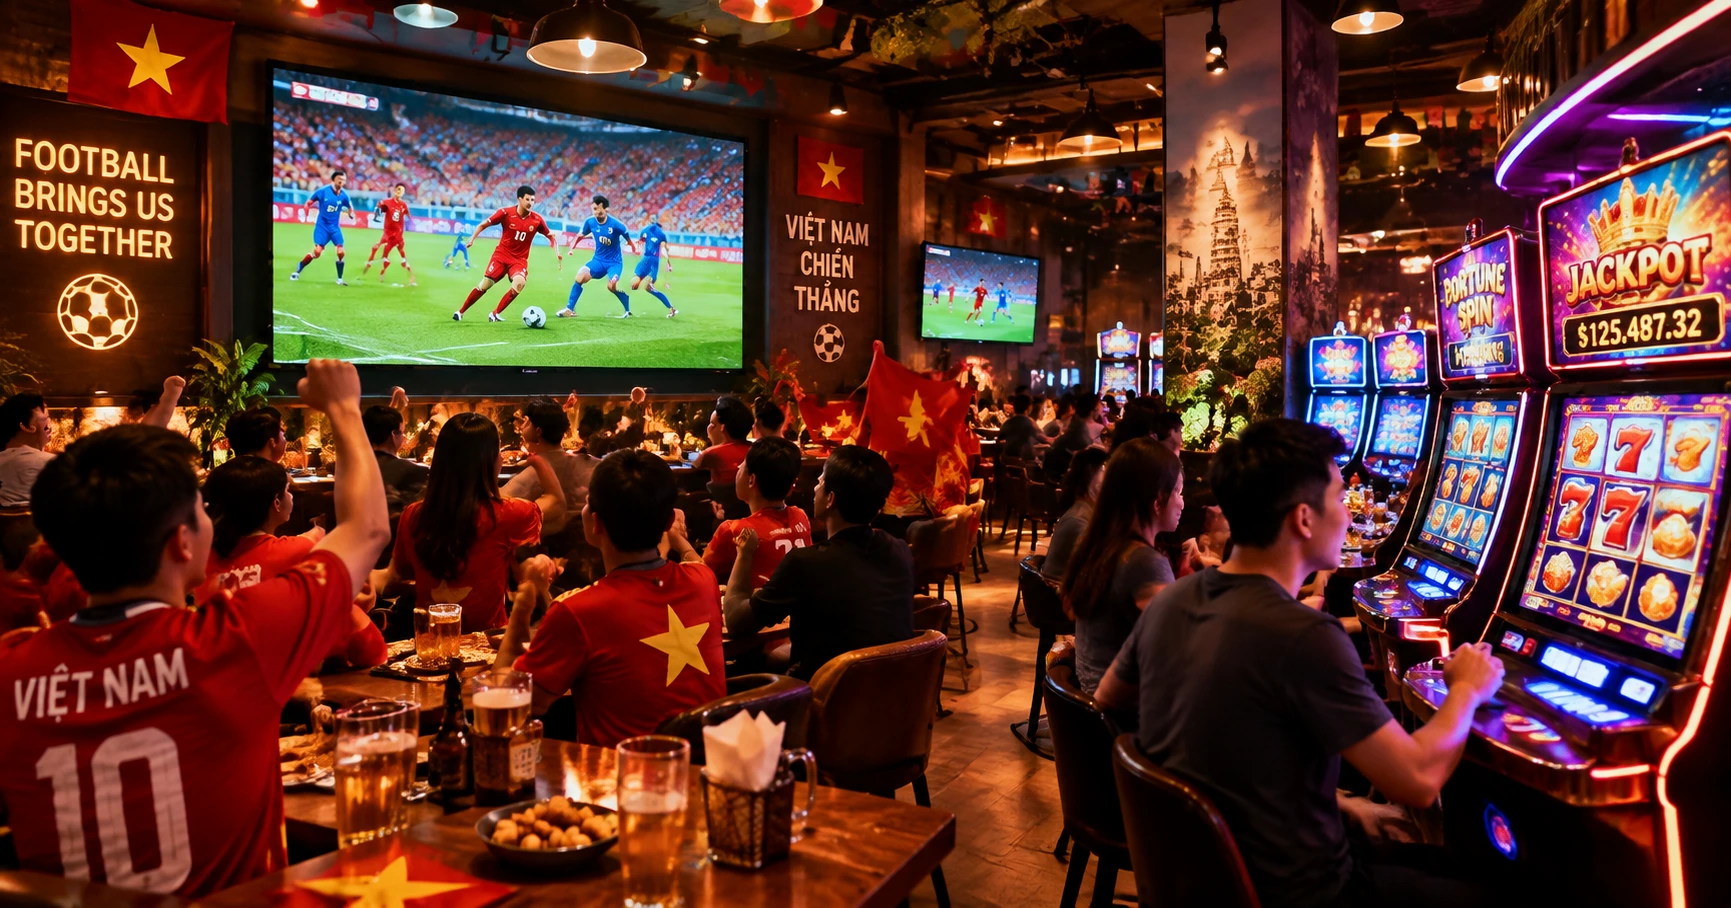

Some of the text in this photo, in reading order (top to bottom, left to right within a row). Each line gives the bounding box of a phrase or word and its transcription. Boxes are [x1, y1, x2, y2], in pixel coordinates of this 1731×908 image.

[15, 138, 175, 184] FOOTBALL
[15, 178, 174, 222] BRINGS US
[14, 219, 173, 259] TOGETHER
[514, 230, 527, 242] 10
[785, 211, 869, 247] VIỆT NAM
[1565, 235, 1711, 305] JACKPOT
[1457, 295, 1494, 333] SPIN
[14, 647, 189, 723] VIỆT NAM
[35, 727, 192, 894] 10
